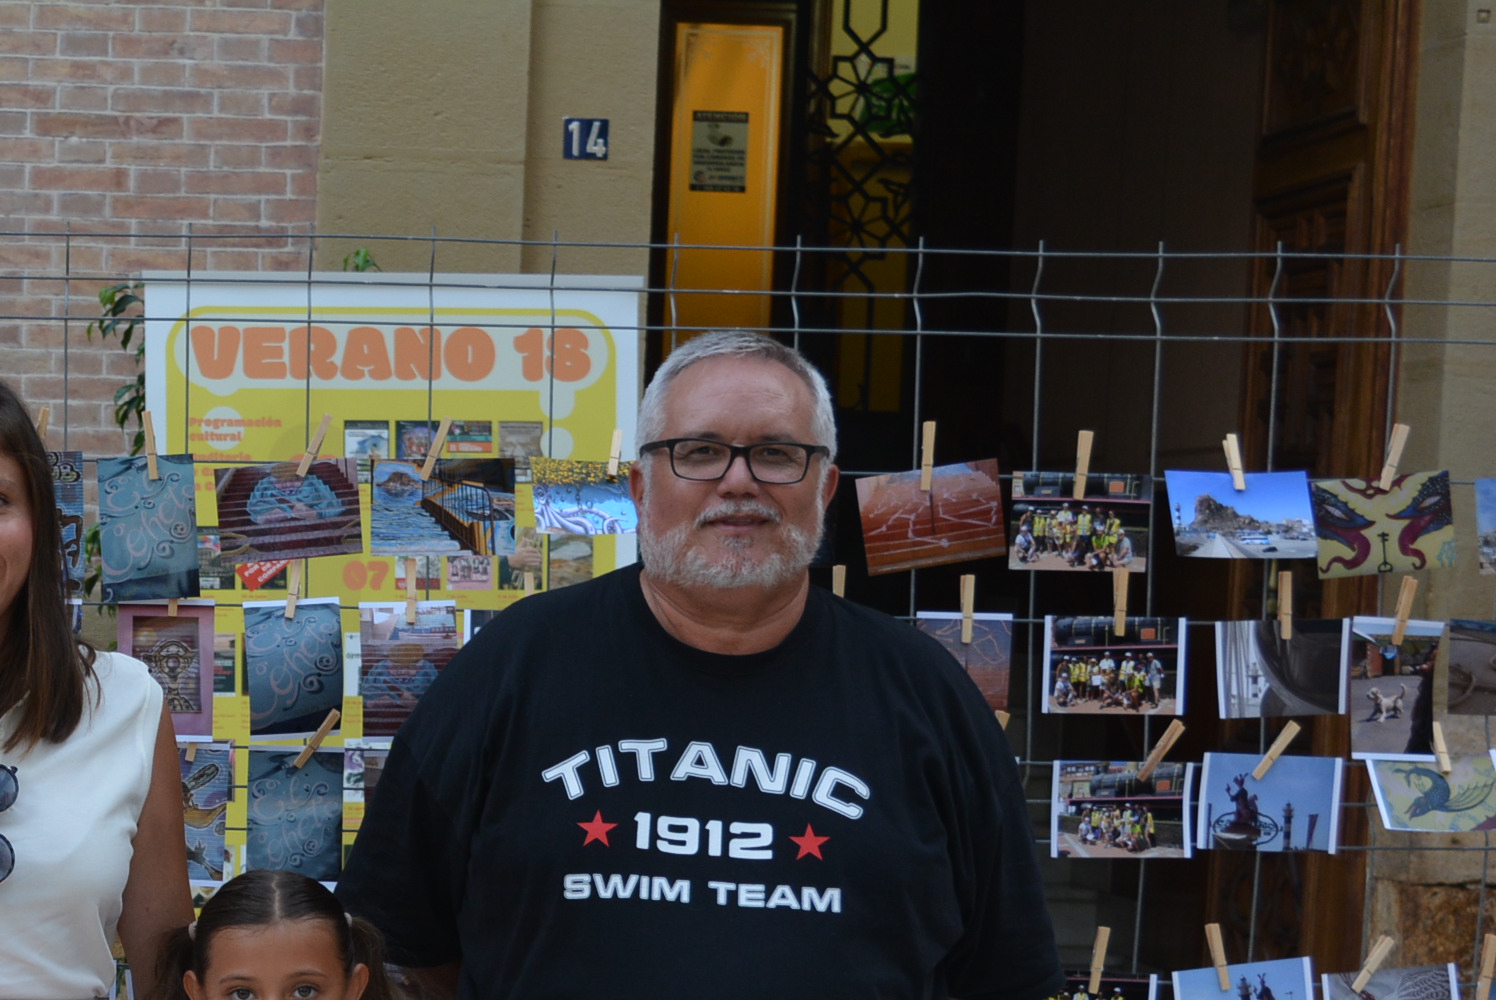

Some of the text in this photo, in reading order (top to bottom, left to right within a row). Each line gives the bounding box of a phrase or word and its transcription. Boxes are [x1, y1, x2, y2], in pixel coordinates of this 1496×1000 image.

[568, 121, 607, 158] 14
[191, 325, 592, 383] VERANO 18
[189, 416, 282, 430] Programación
[189, 431, 242, 442] cultural
[342, 560, 390, 591] 07
[541, 737, 871, 820] TITANIC
[633, 811, 774, 860] 1912
[563, 873, 842, 914] SWIM TEAM
